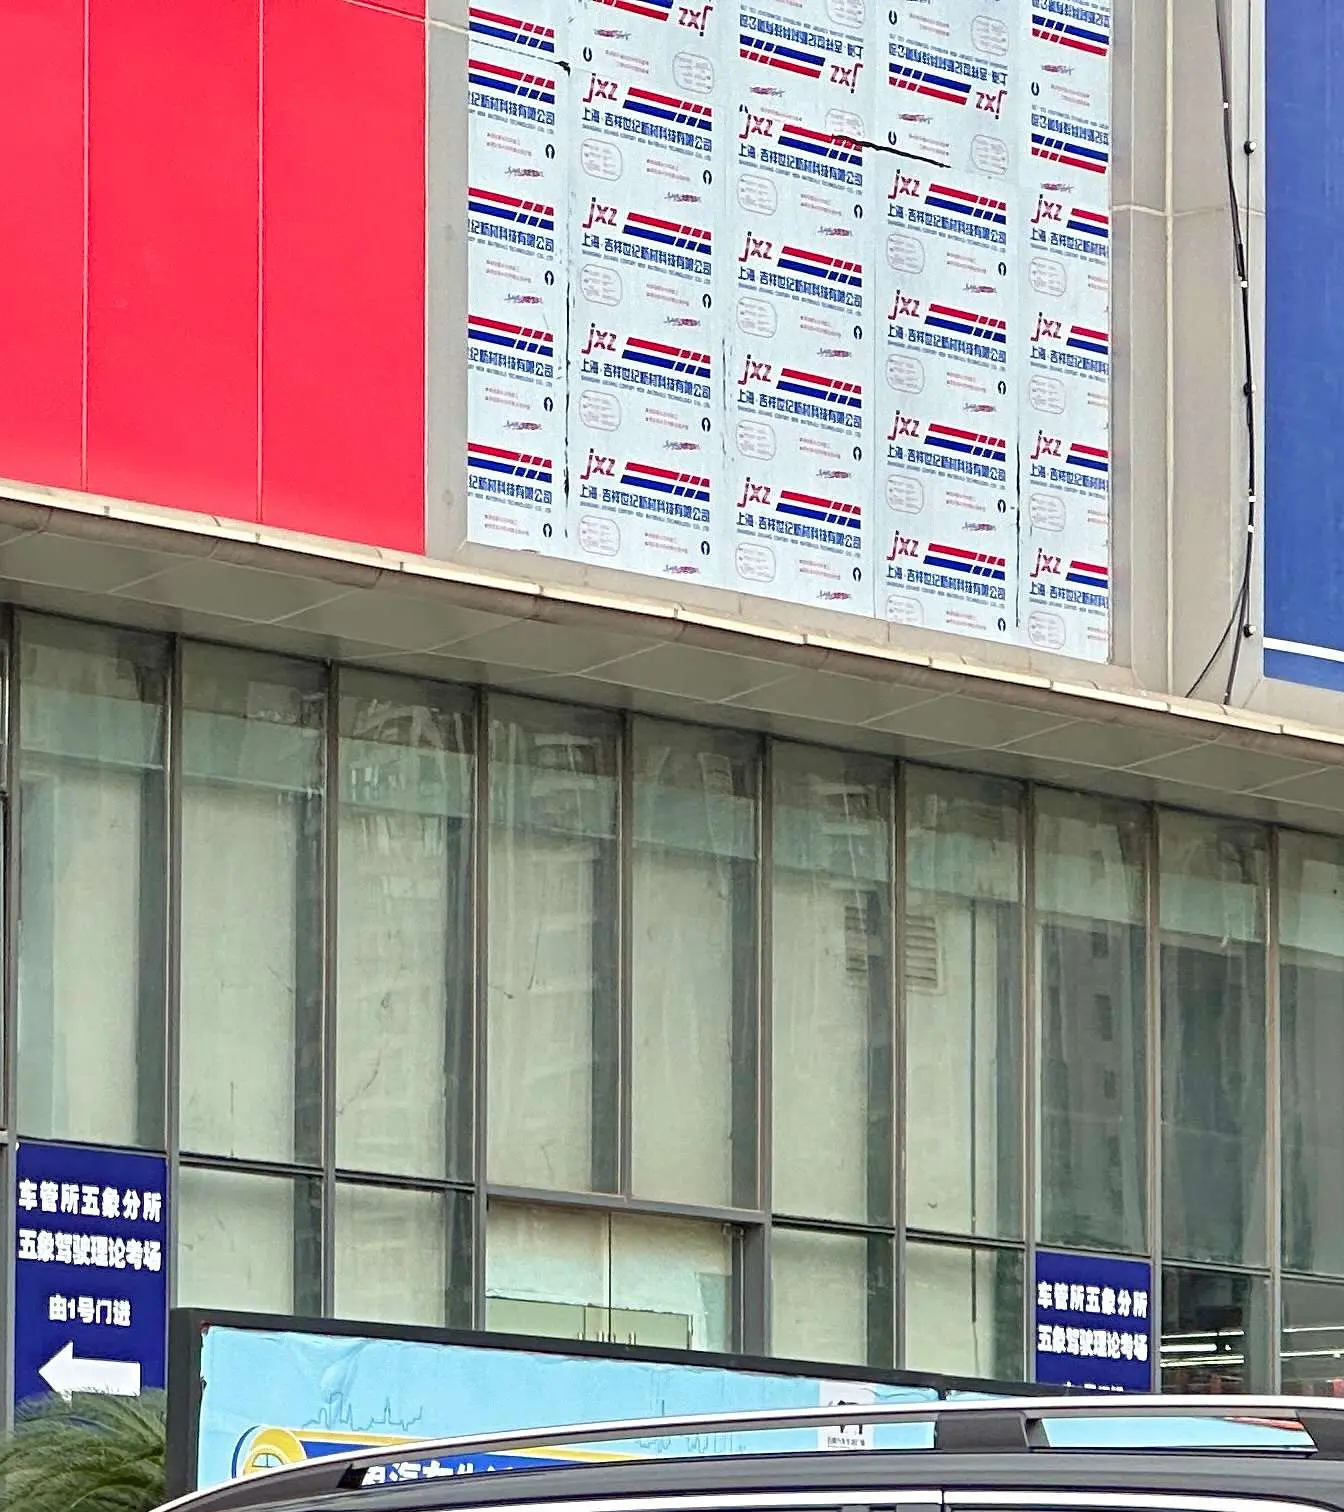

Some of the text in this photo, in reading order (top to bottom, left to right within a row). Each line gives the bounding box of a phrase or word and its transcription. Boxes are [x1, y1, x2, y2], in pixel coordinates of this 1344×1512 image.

[582, 72, 619, 103] jxz
[887, 168, 920, 200] jxz
[582, 197, 618, 229] jxz
[1031, 194, 1063, 224] jxz
[738, 231, 773, 263] jxz
[887, 289, 920, 321] jxz
[581, 322, 617, 355] jxz
[1031, 312, 1062, 342] jxz
[737, 354, 772, 385] jxz
[887, 410, 920, 441] jxz
[1030, 430, 1062, 460] jxz
[580, 448, 616, 481] jxz
[737, 477, 771, 508] jxz
[886, 530, 919, 561] jxz
[1030, 548, 1061, 577] jxz
[18, 1178, 162, 1222] 车管所五象分所
[18, 1228, 162, 1272] 五象驾驶理论考场
[48, 1294, 131, 1327] 由1号门进
[1037, 1280, 1148, 1319] 车管所五象分所
[1037, 1324, 1148, 1362] 五象驾驶理论考场
